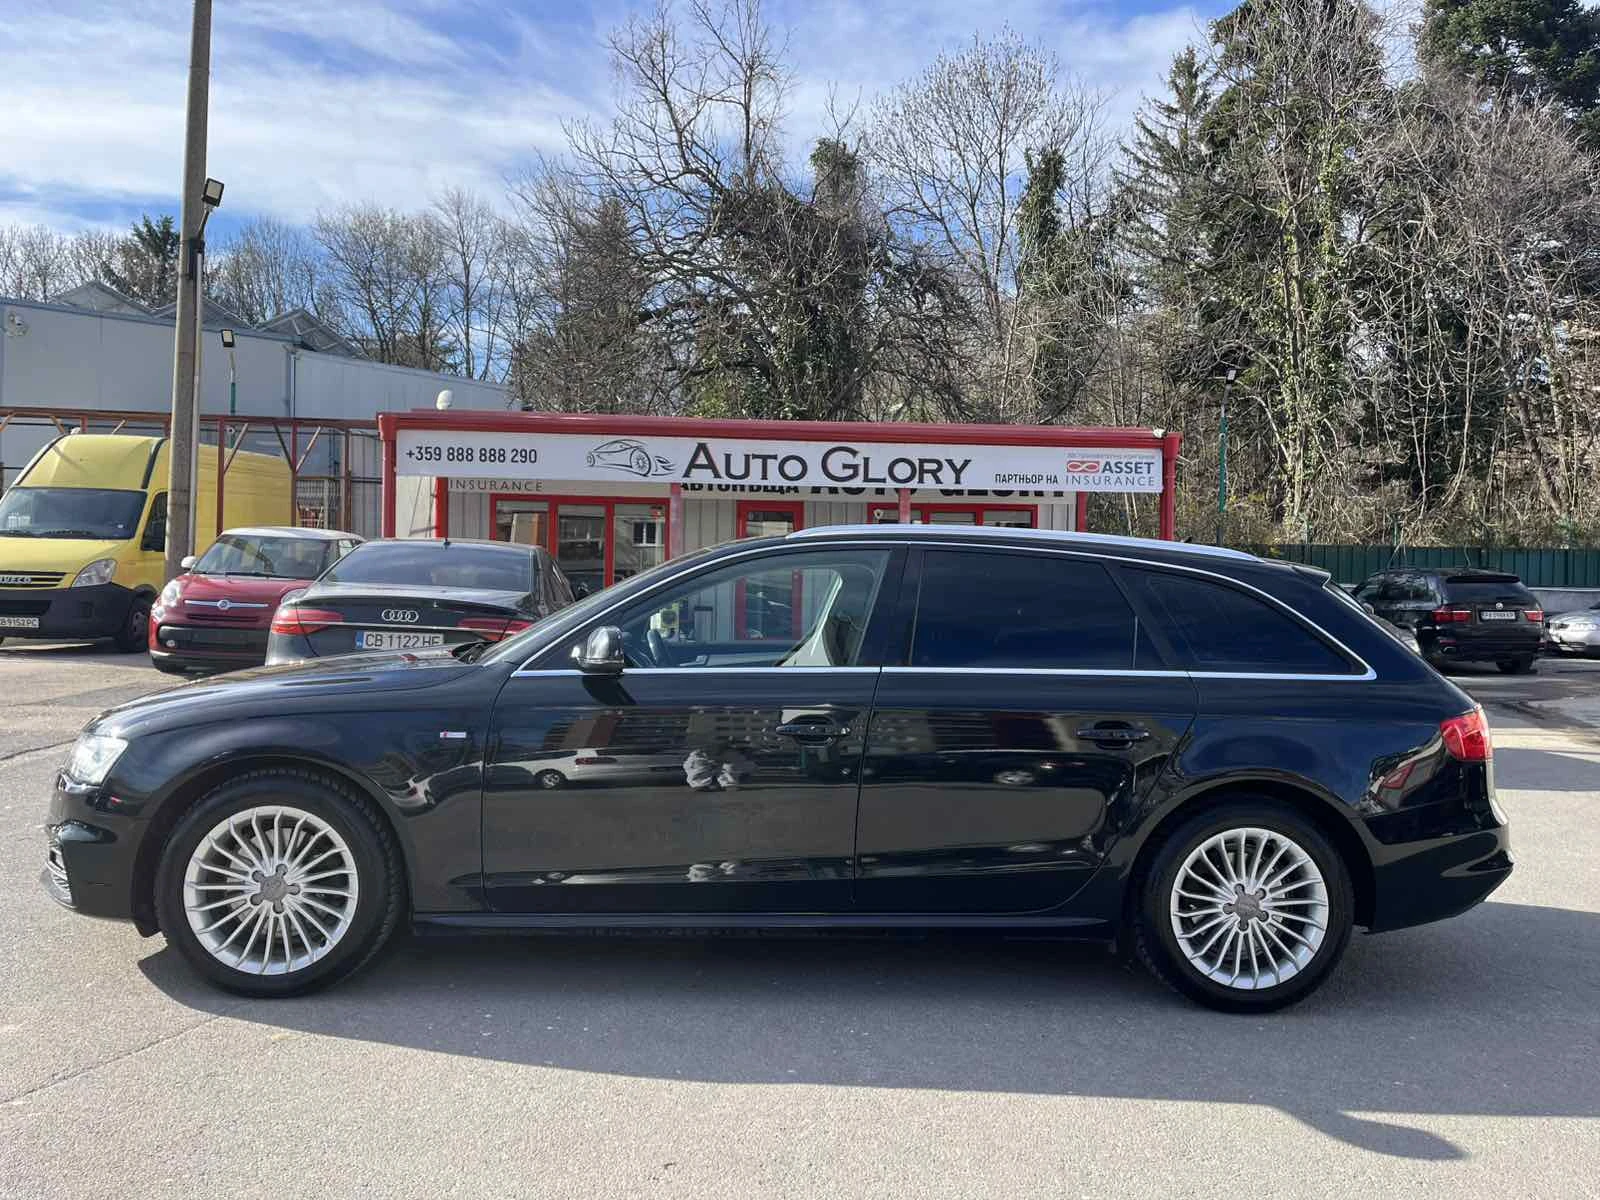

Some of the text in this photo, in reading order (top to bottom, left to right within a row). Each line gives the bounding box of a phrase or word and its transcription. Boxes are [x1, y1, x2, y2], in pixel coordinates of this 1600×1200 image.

[406, 446, 538, 464] +359 888 888 290
[682, 442, 971, 485] AUTO GLORY
[1102, 461, 1155, 475] ASSET
[449, 479, 544, 492] INSURANCE
[994, 473, 1058, 485] ПАРТНЬОР НА
[1065, 474, 1155, 487] INSURANCE
[365, 633, 383, 648] CB
